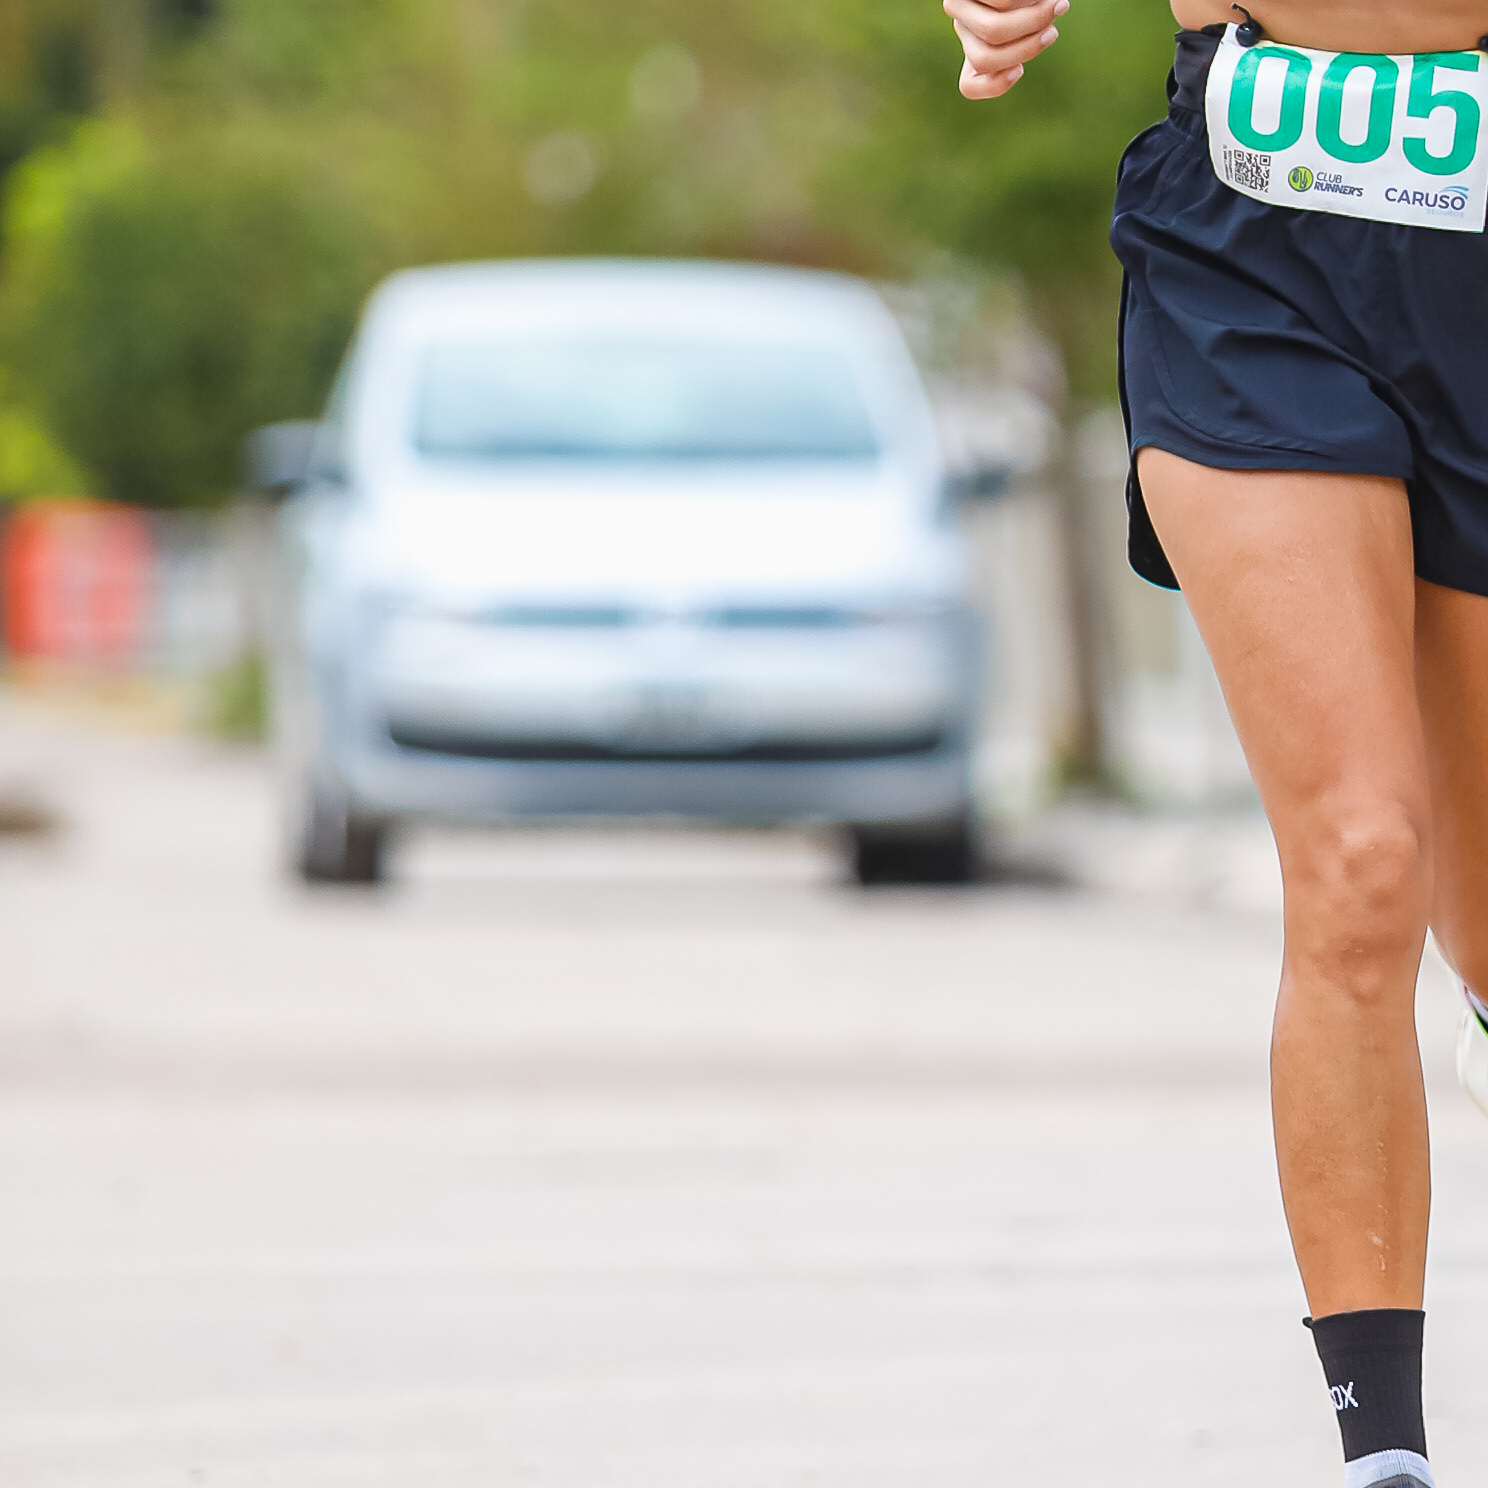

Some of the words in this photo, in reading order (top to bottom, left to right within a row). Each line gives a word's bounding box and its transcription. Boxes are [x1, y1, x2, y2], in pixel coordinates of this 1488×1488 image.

[1228, 46, 1481, 176] 005
[1316, 171, 1343, 184] CLUB
[1384, 187, 1466, 211] CARUSO
[1329, 1381, 1359, 1411] OX
